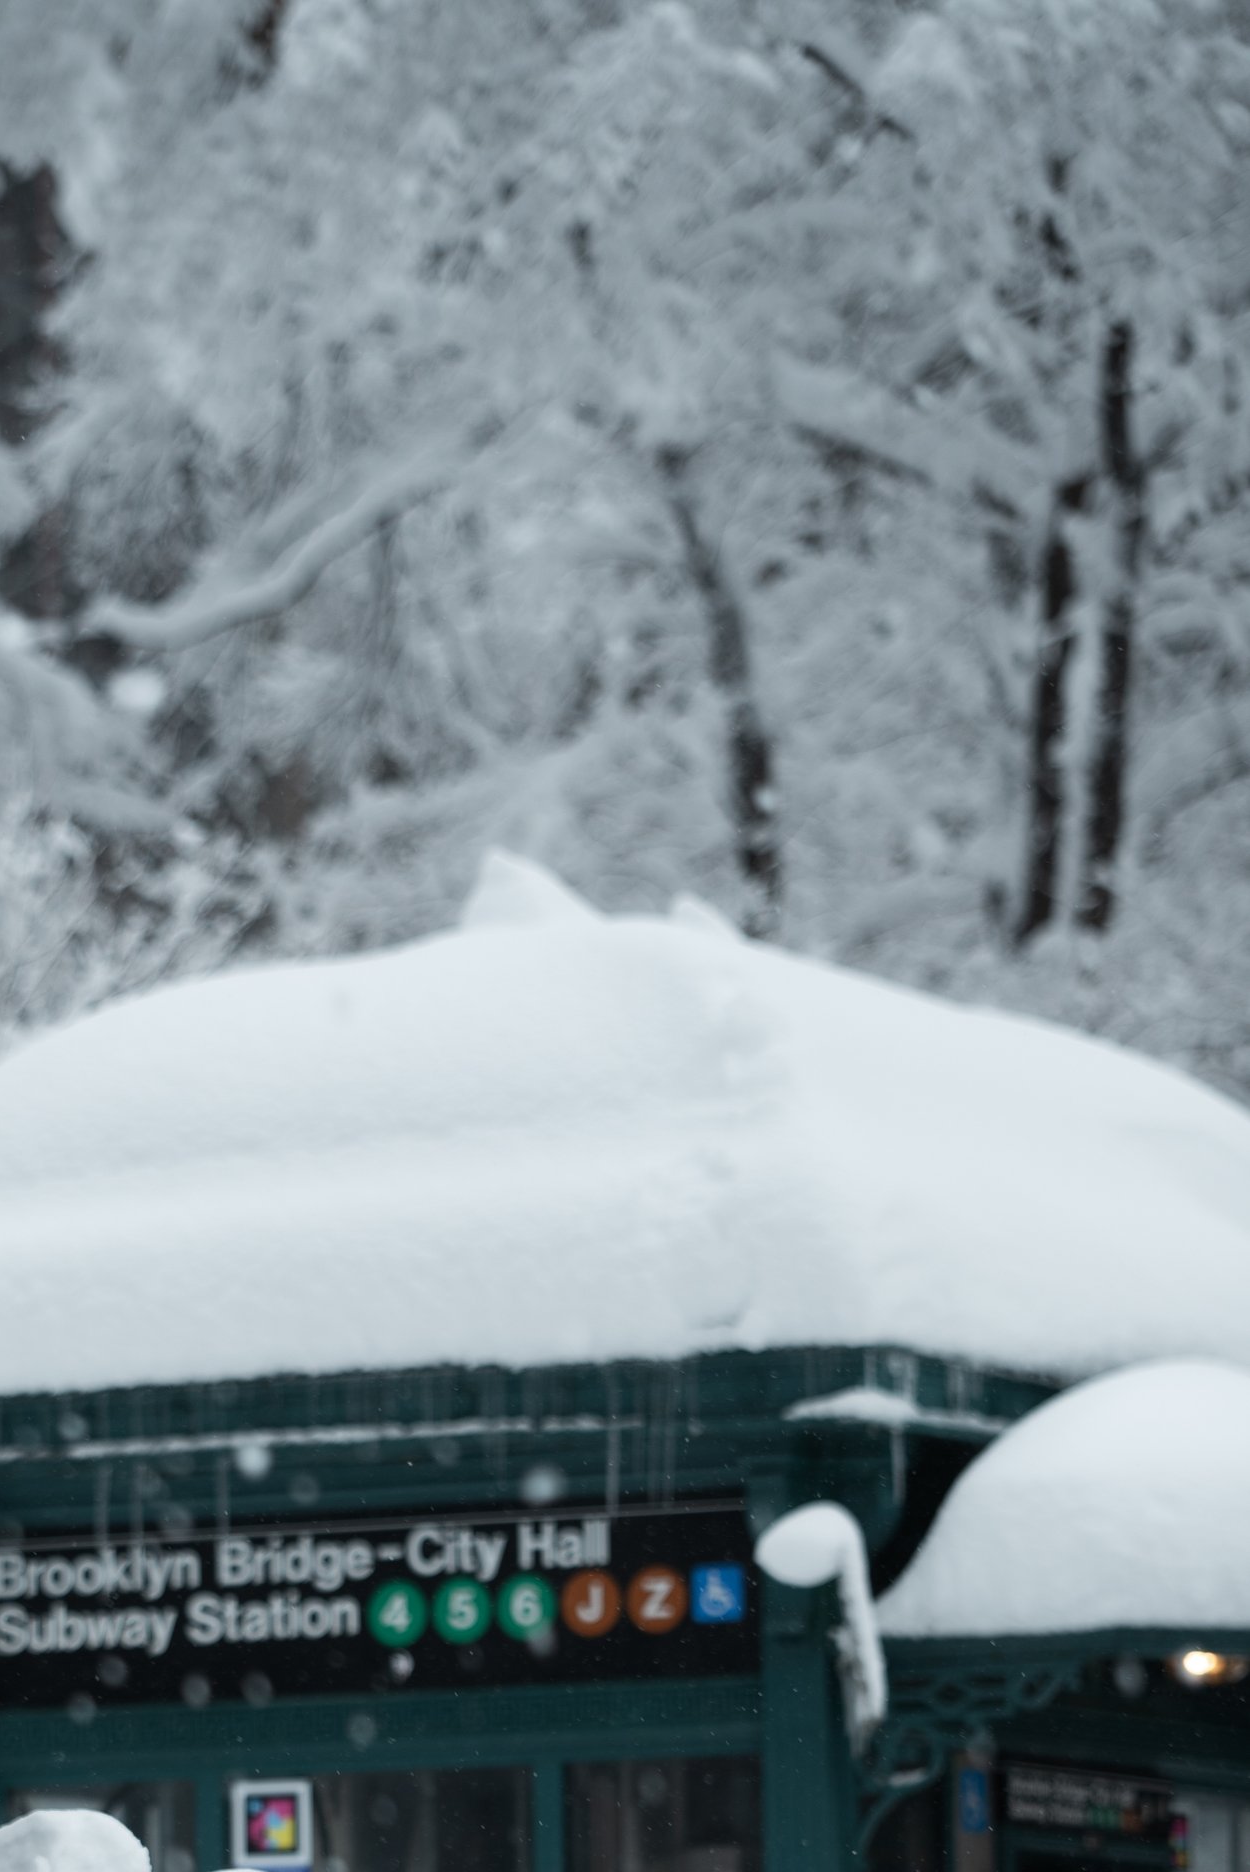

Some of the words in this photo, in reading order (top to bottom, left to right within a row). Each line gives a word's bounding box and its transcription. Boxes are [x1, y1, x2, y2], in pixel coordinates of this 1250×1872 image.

[519, 1519, 610, 1570] Hall
[187, 1594, 360, 1646] Station
[381, 1595, 410, 1633] 4
[447, 1589, 477, 1630] 5
[511, 1585, 541, 1626] 6
[577, 1586, 606, 1623] J
[643, 1582, 672, 1620] Z
